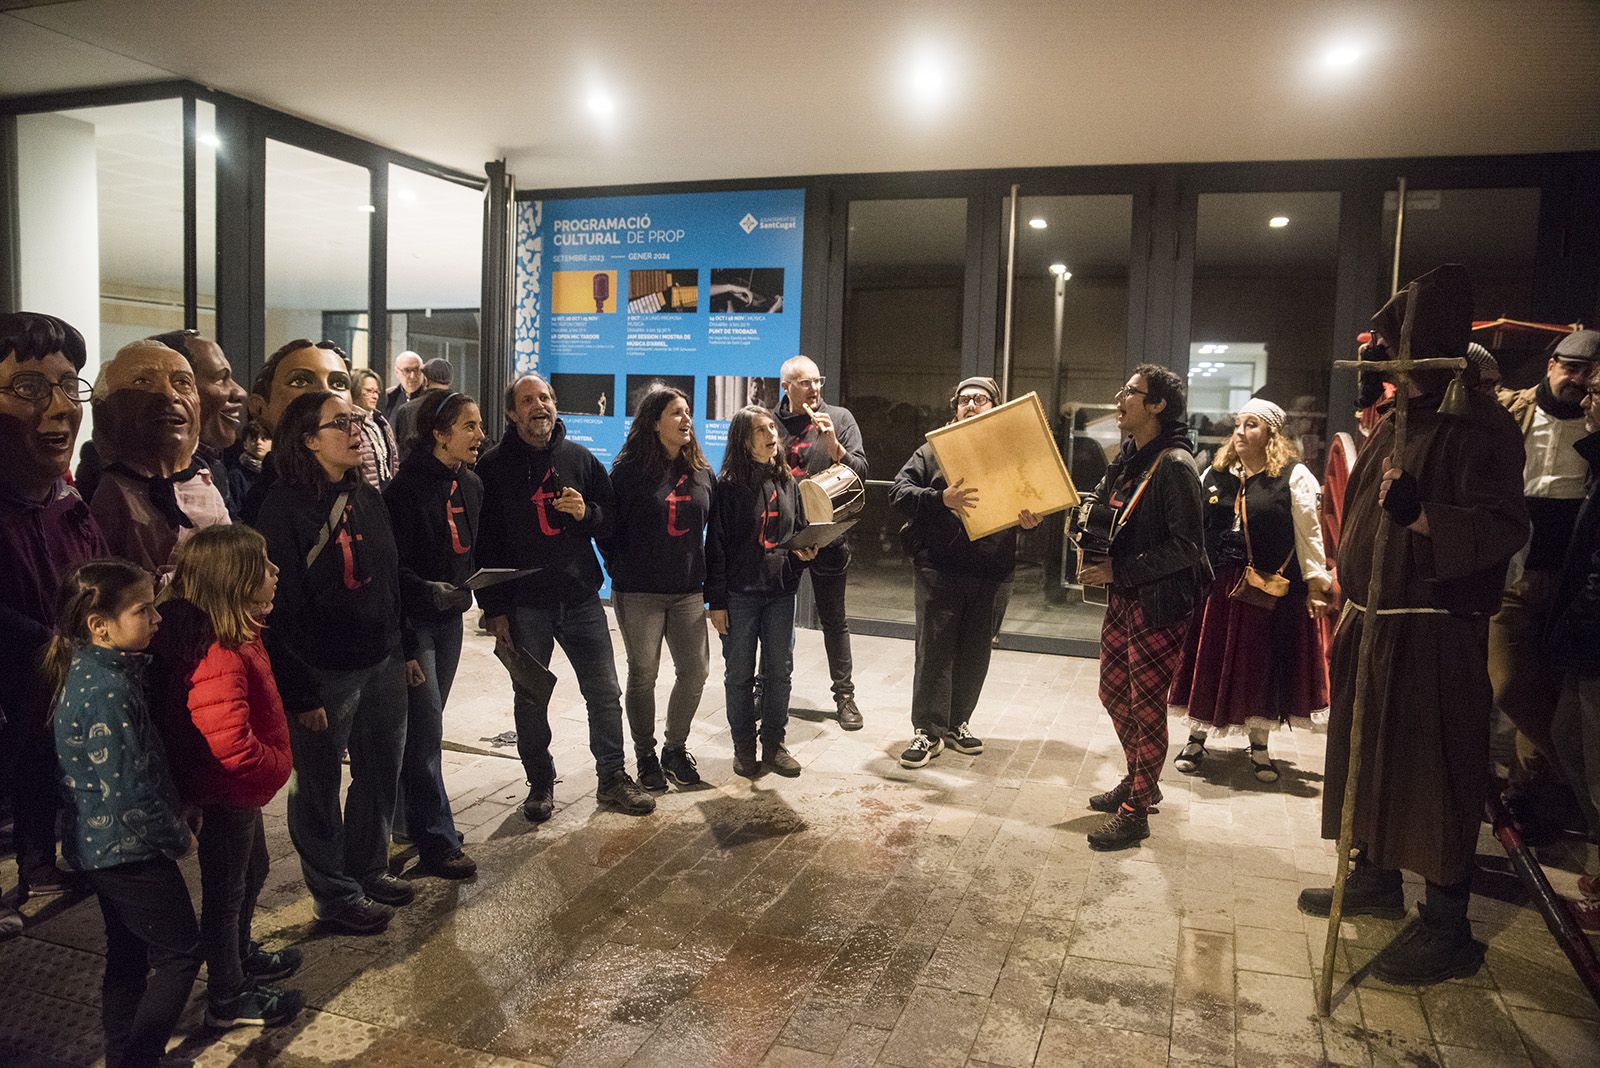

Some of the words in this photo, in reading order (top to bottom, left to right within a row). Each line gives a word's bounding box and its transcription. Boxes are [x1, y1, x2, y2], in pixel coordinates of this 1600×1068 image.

[554, 214, 651, 234] PROGRAMACIÓ
[553, 231, 620, 246] CULTURAL
[626, 231, 644, 244] DE
[648, 230, 685, 242] PROP
[552, 254, 588, 262] SETEMBRE
[628, 252, 652, 260] GENER
